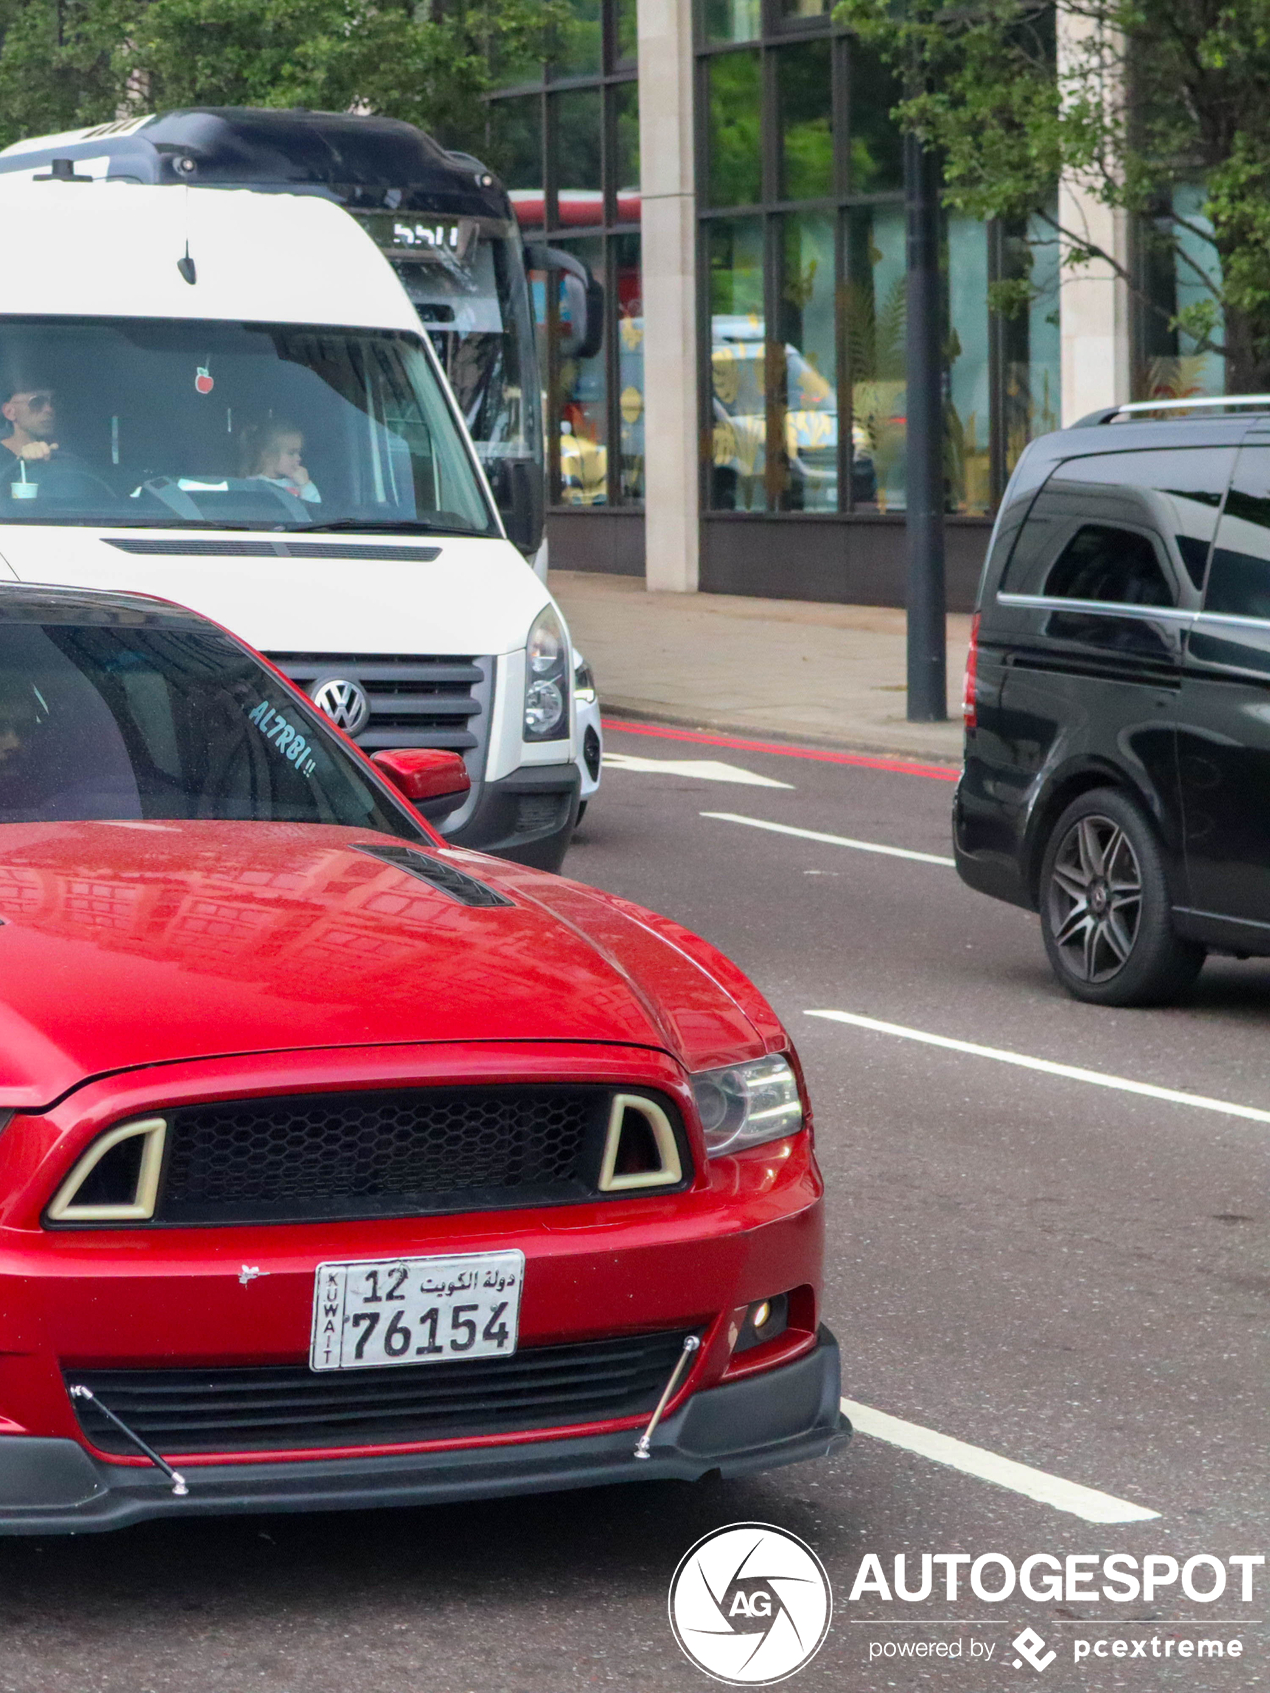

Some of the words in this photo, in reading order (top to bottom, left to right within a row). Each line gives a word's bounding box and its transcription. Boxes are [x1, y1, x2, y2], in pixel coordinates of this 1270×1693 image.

[362, 1268, 409, 1303] 12
[420, 1270, 479, 1297] الكويت
[482, 1268, 516, 1292] دولة
[323, 1273, 340, 1364] KUWAIT
[351, 1301, 509, 1360] 76154
